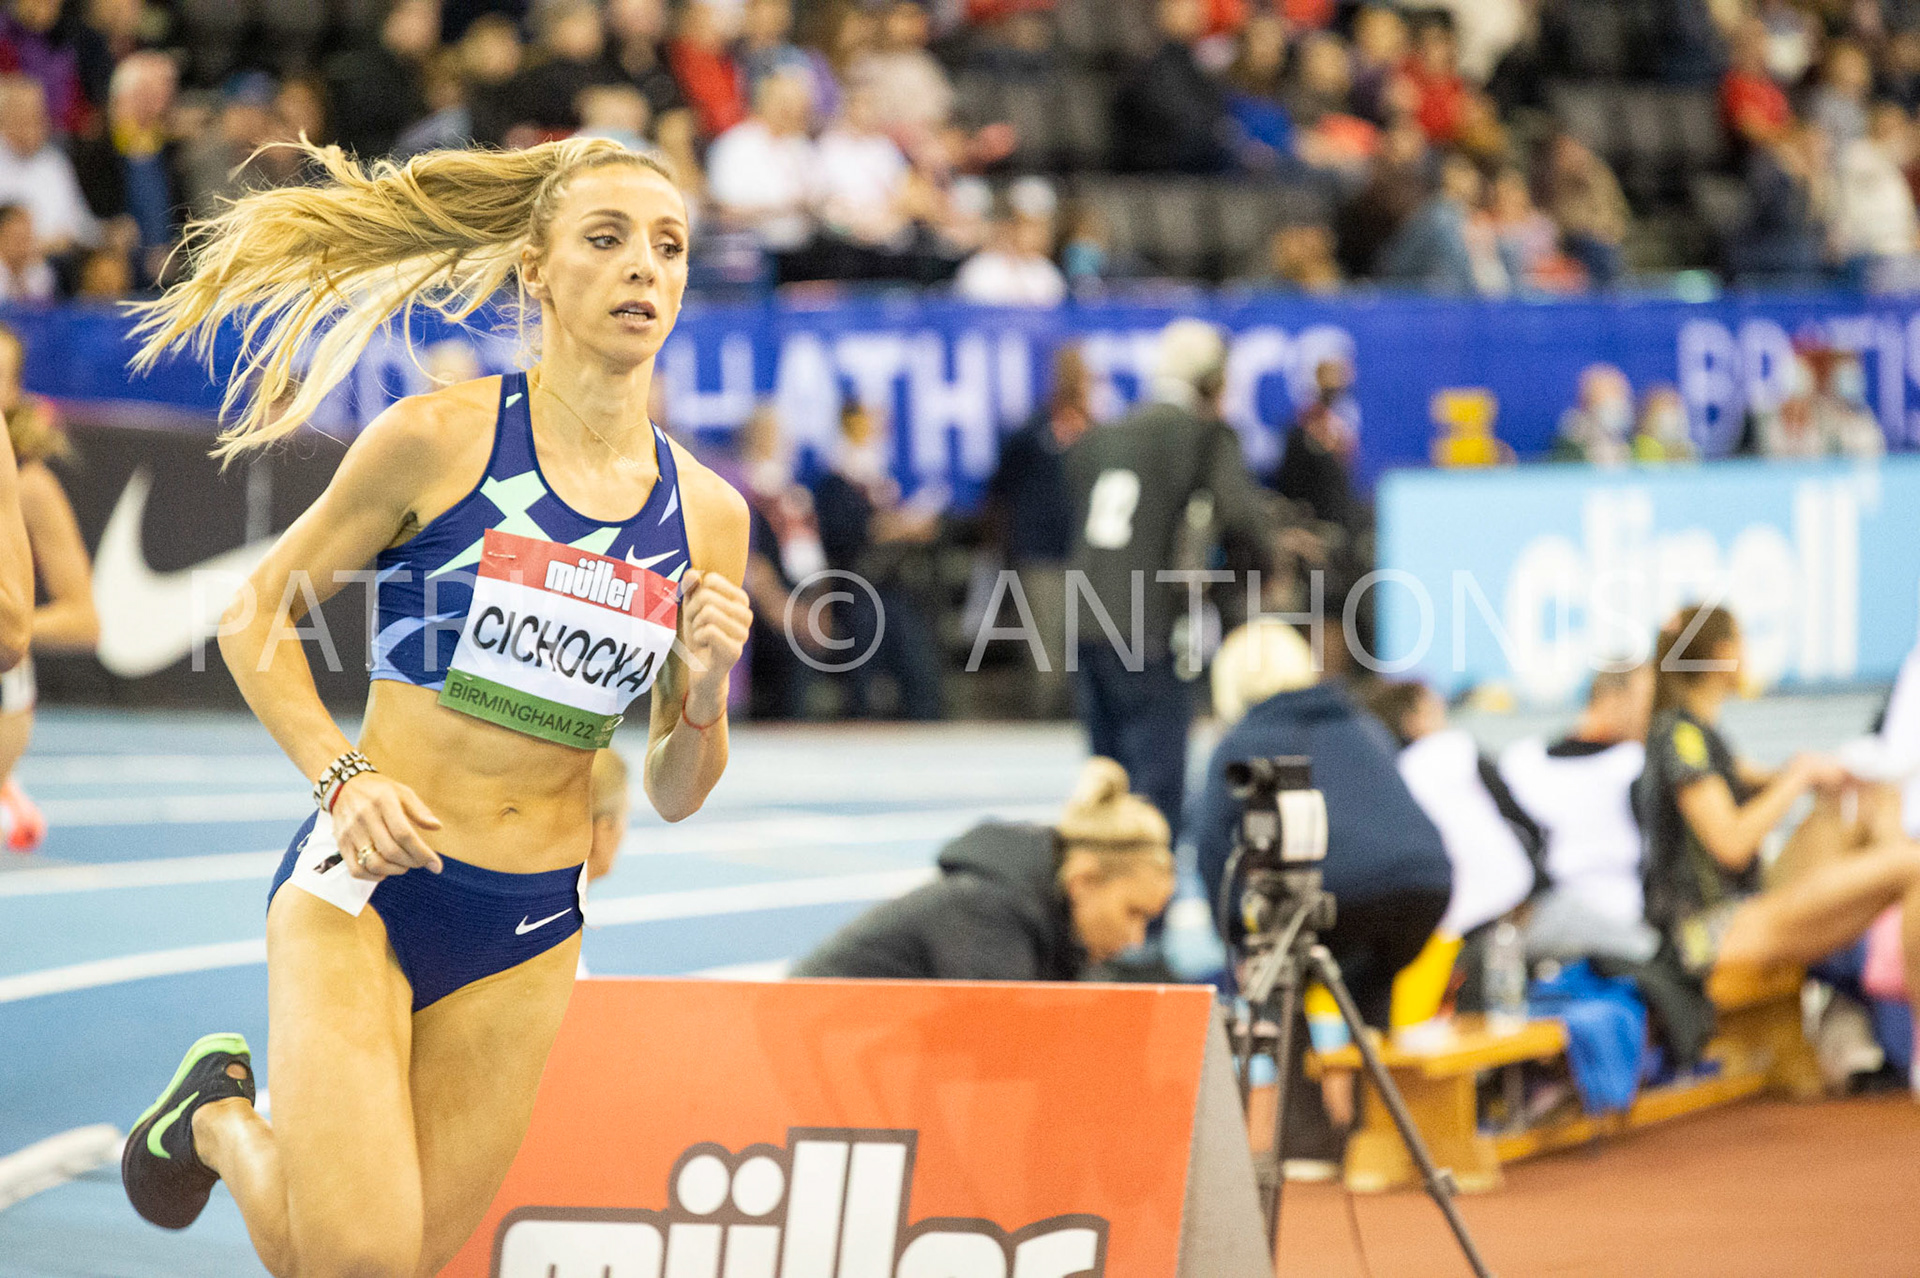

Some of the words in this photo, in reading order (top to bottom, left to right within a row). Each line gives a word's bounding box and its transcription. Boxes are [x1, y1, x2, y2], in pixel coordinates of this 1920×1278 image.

[774, 325, 1360, 479] ATHLCS
[544, 558, 638, 612] müller
[472, 606, 656, 693] CICHOCKA
[449, 682, 572, 735] BIRMINGHAM
[573, 722, 595, 740] 22
[494, 1132, 1106, 1278] üll
